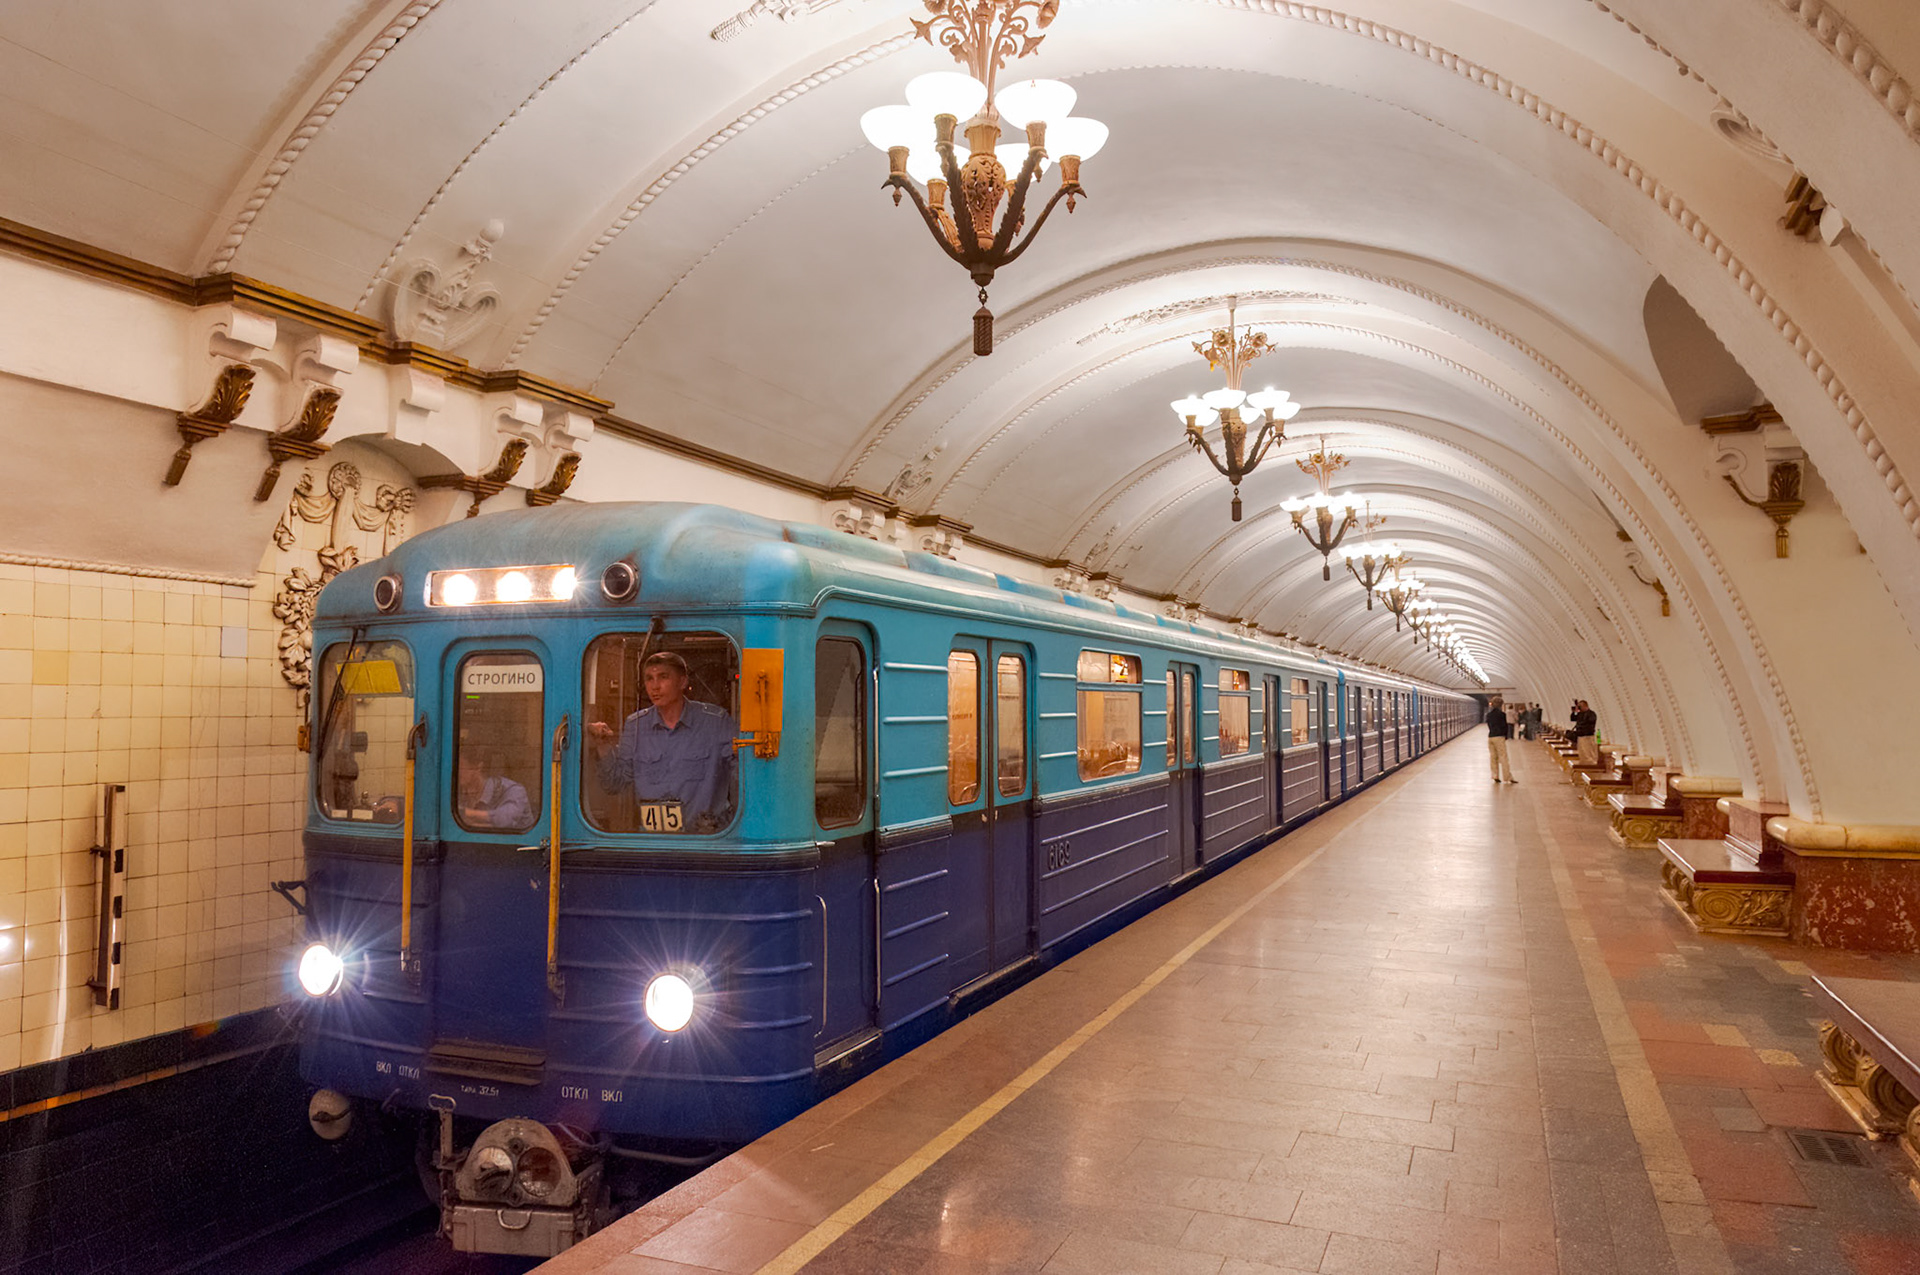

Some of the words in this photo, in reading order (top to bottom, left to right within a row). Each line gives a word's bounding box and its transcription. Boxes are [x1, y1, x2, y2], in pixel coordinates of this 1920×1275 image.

[467, 672, 536, 685] СТРОГИНО
[646, 805, 678, 829] 45
[376, 1061, 391, 1073] ВКЛ
[398, 1065, 419, 1079] ОТКЛ
[561, 1086, 588, 1099] ОТКЛ
[601, 1089, 622, 1102] ВКЛ
